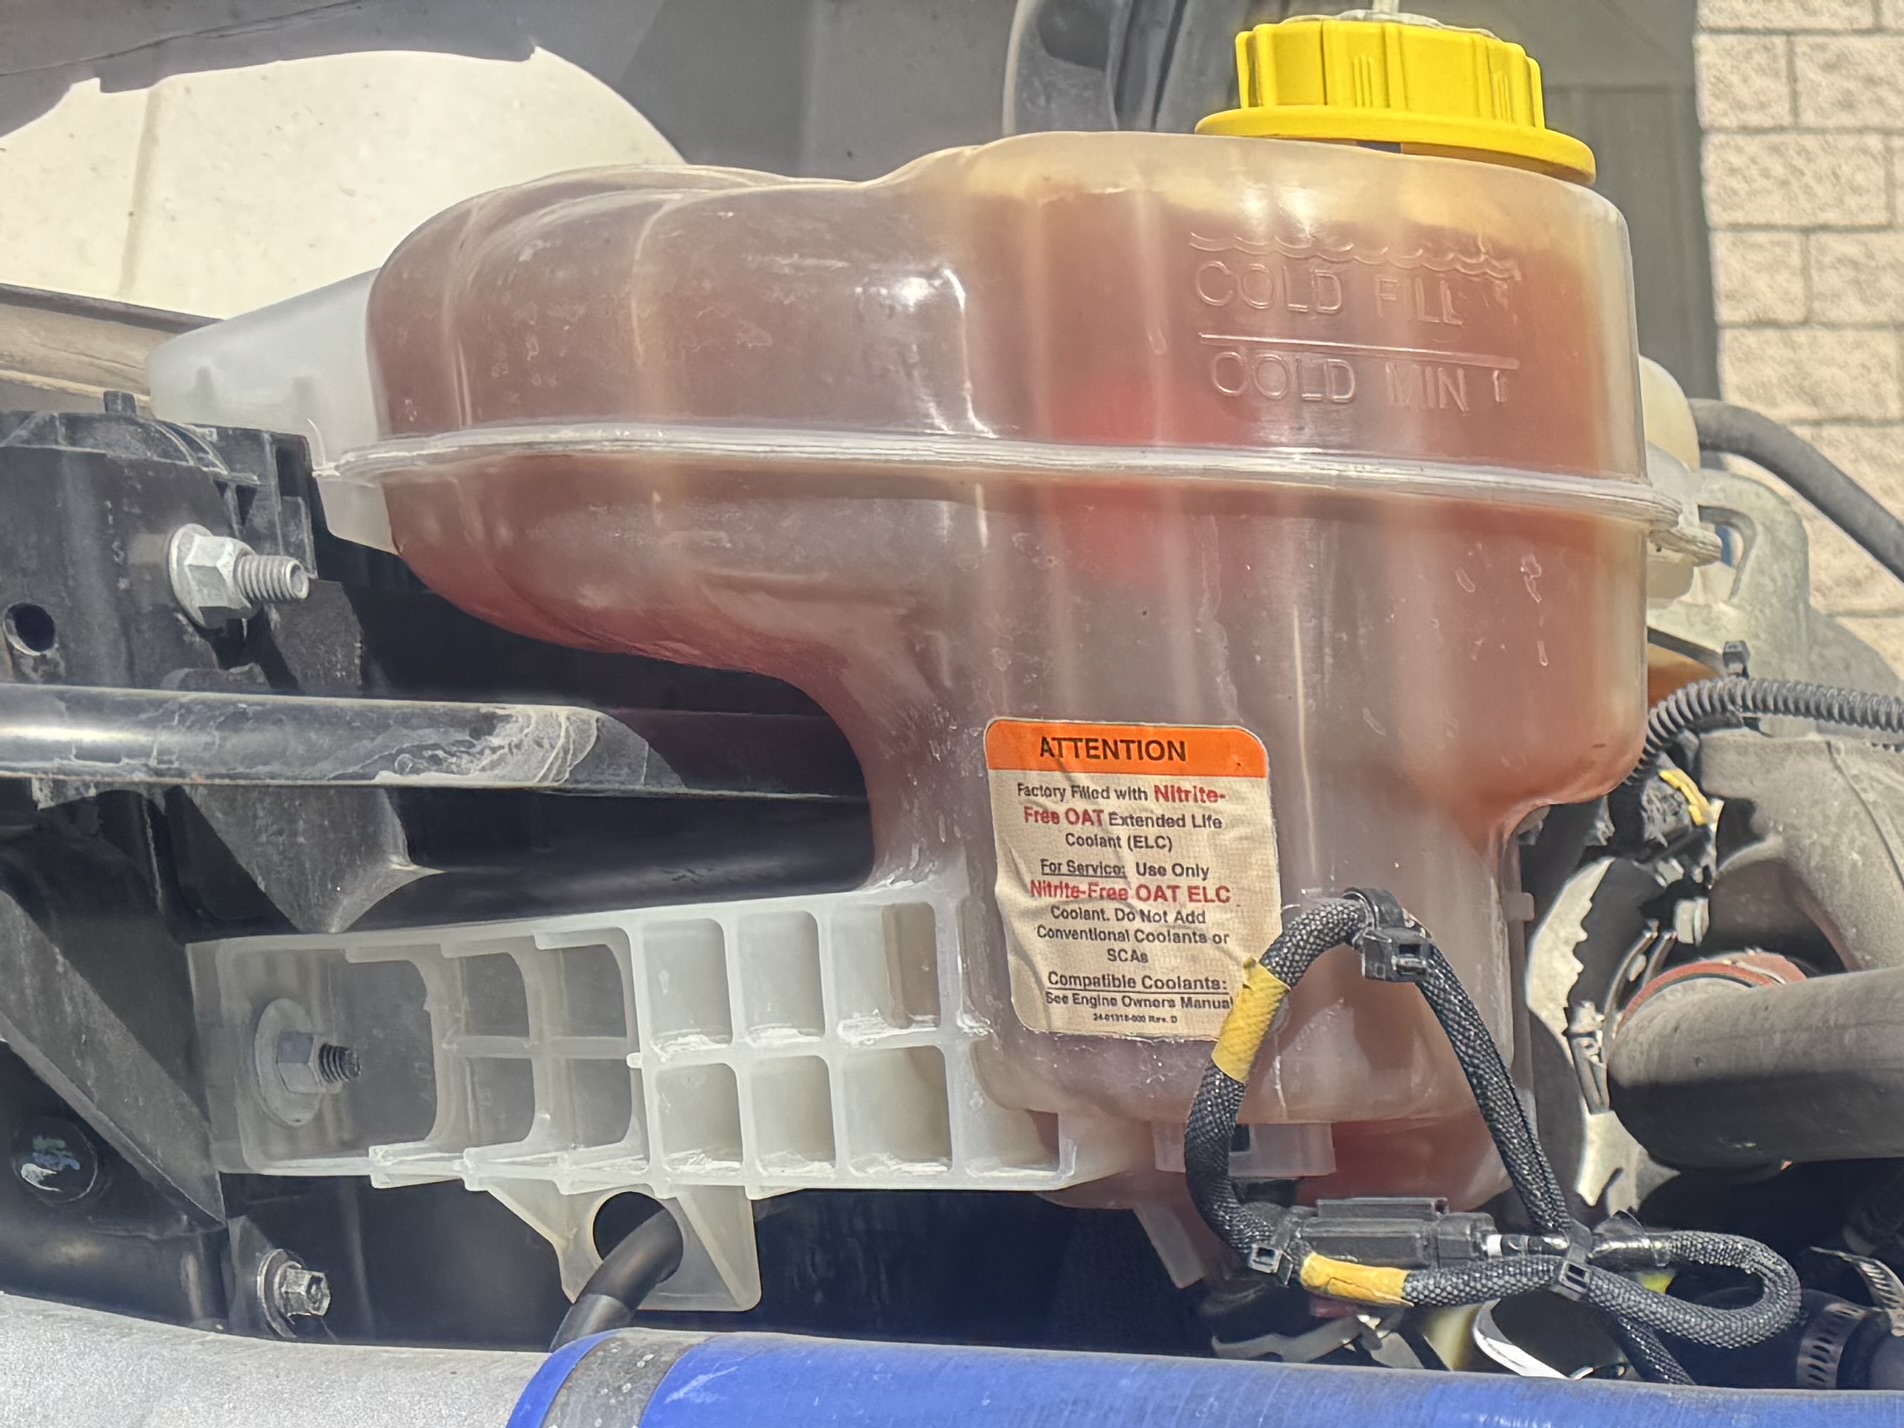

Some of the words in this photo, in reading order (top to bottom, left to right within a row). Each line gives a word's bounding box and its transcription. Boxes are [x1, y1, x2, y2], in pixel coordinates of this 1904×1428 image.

[1195, 259, 1343, 315] COLD
[1375, 276, 1464, 327] FILL
[1211, 350, 1356, 403] COLD
[1386, 361, 1469, 416] MIN
[1040, 737, 1187, 762] ATTENTION
[1018, 783, 1066, 801] Factory
[1071, 785, 1110, 800] Filled
[1114, 787, 1148, 801] with
[1154, 785, 1226, 803] Nitrite-
[1024, 807, 1060, 825] Free
[1065, 809, 1104, 827] OAT
[1109, 813, 1186, 828] Extended
[1192, 815, 1222, 828] Life
[1065, 833, 1122, 848] Coolant
[1127, 835, 1173, 852] (ELC)
[1041, 860, 1062, 874] For
[1067, 861, 1126, 876] Service:
[1136, 862, 1167, 877] Use
[1172, 864, 1209, 880] Only
[1030, 880, 1129, 901] Nitrite-Free
[1135, 885, 1180, 902] OAT
[1189, 886, 1232, 903] ELC
[1051, 906, 1110, 921] Coolant.
[1115, 908, 1136, 922] Do
[1140, 909, 1168, 923] Not
[1174, 910, 1206, 924] Add
[1037, 925, 1130, 942] Conventional
[1134, 929, 1207, 944] Coolants
[1212, 933, 1229, 944] or
[1107, 949, 1148, 963] SCAs
[1048, 971, 1136, 989] Compatible
[1141, 975, 1227, 991] Coolants:
[1046, 992, 1069, 1004] See
[1073, 993, 1117, 1008] Engine
[1122, 996, 1176, 1008] Owners
[1180, 997, 1234, 1009] Manual
